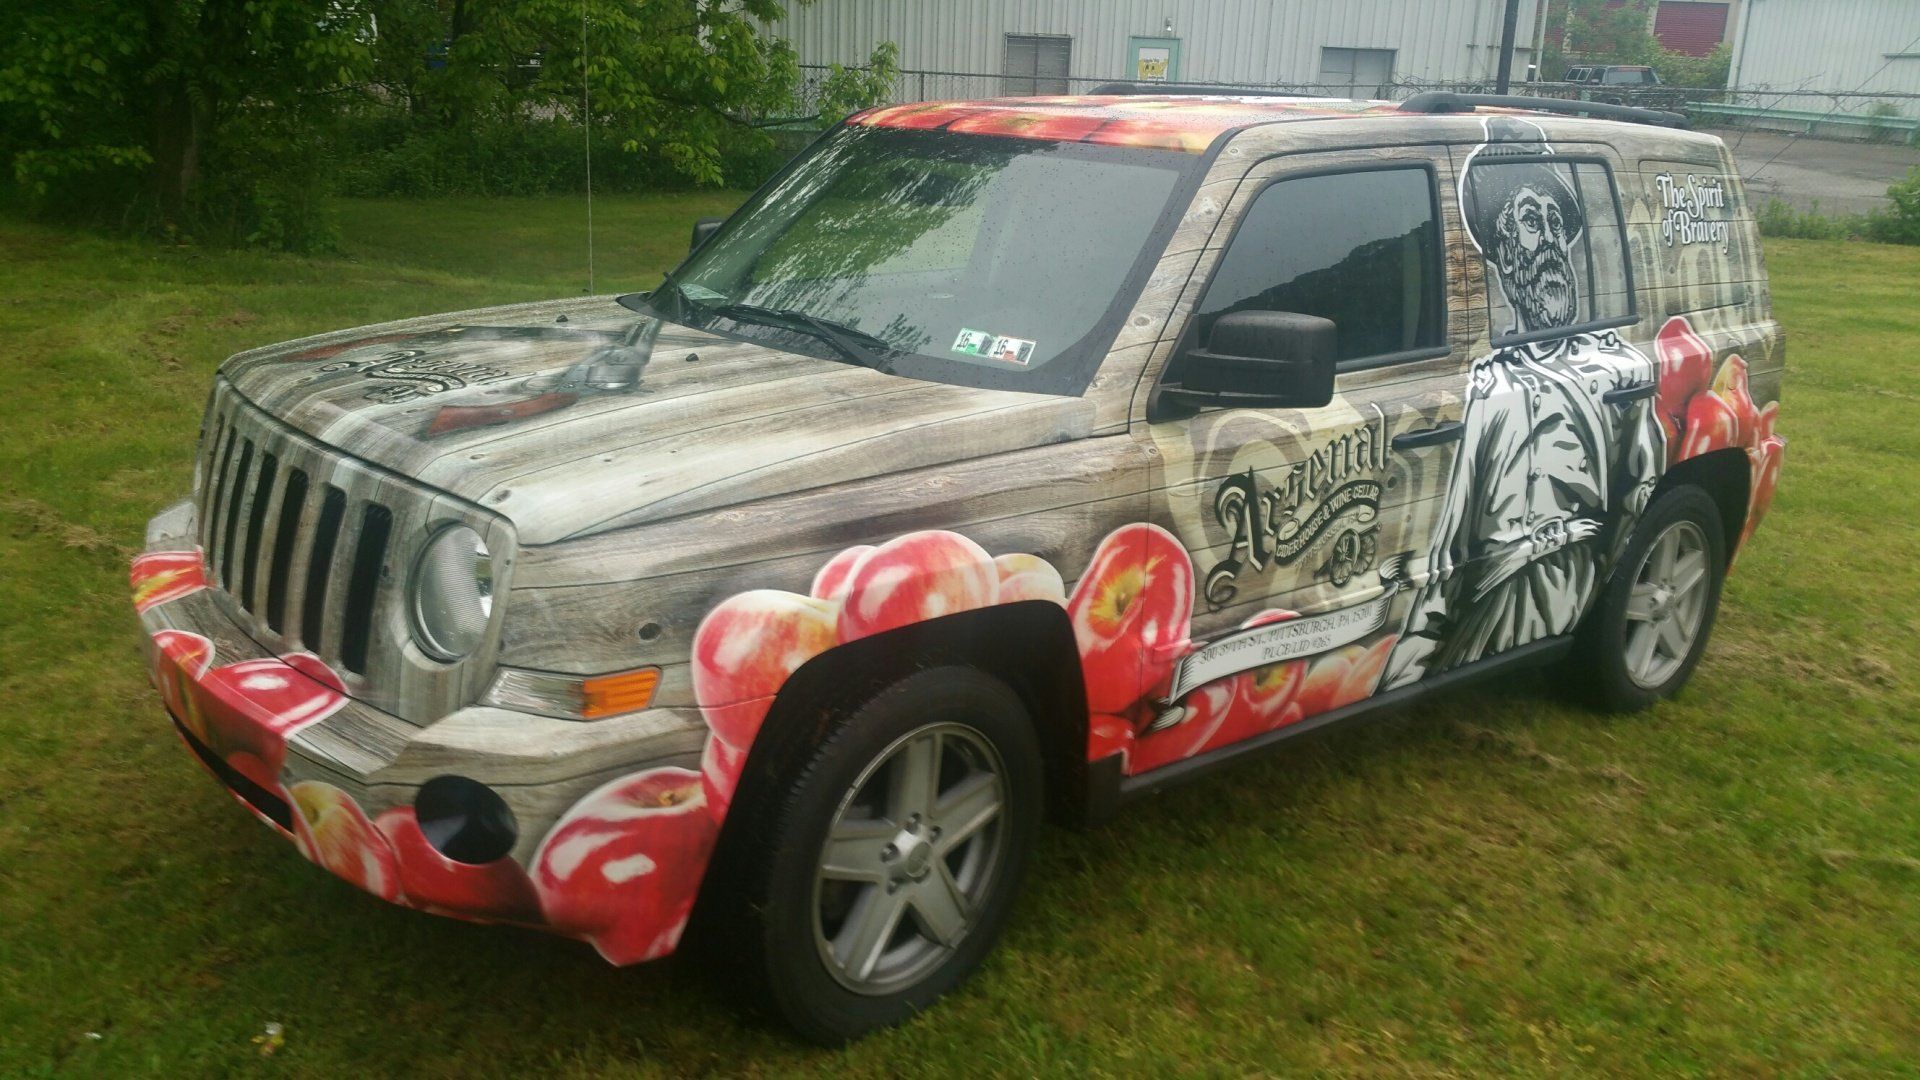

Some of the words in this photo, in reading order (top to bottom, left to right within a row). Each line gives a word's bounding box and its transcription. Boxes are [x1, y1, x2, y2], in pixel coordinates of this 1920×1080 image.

[1655, 171, 1687, 208] The
[1686, 173, 1724, 219] Spirit
[1662, 209, 1674, 247] of
[1673, 210, 1729, 254] Bravery
[957, 332, 972, 348] 16
[993, 338, 1008, 355] 16
[1205, 402, 1386, 612] Arsenal
[1276, 540, 1300, 558] CIDER
[1299, 511, 1324, 547] HOUSE
[1322, 504, 1331, 520] &
[1329, 488, 1352, 512] WINE
[1352, 484, 1380, 502] CELLAR
